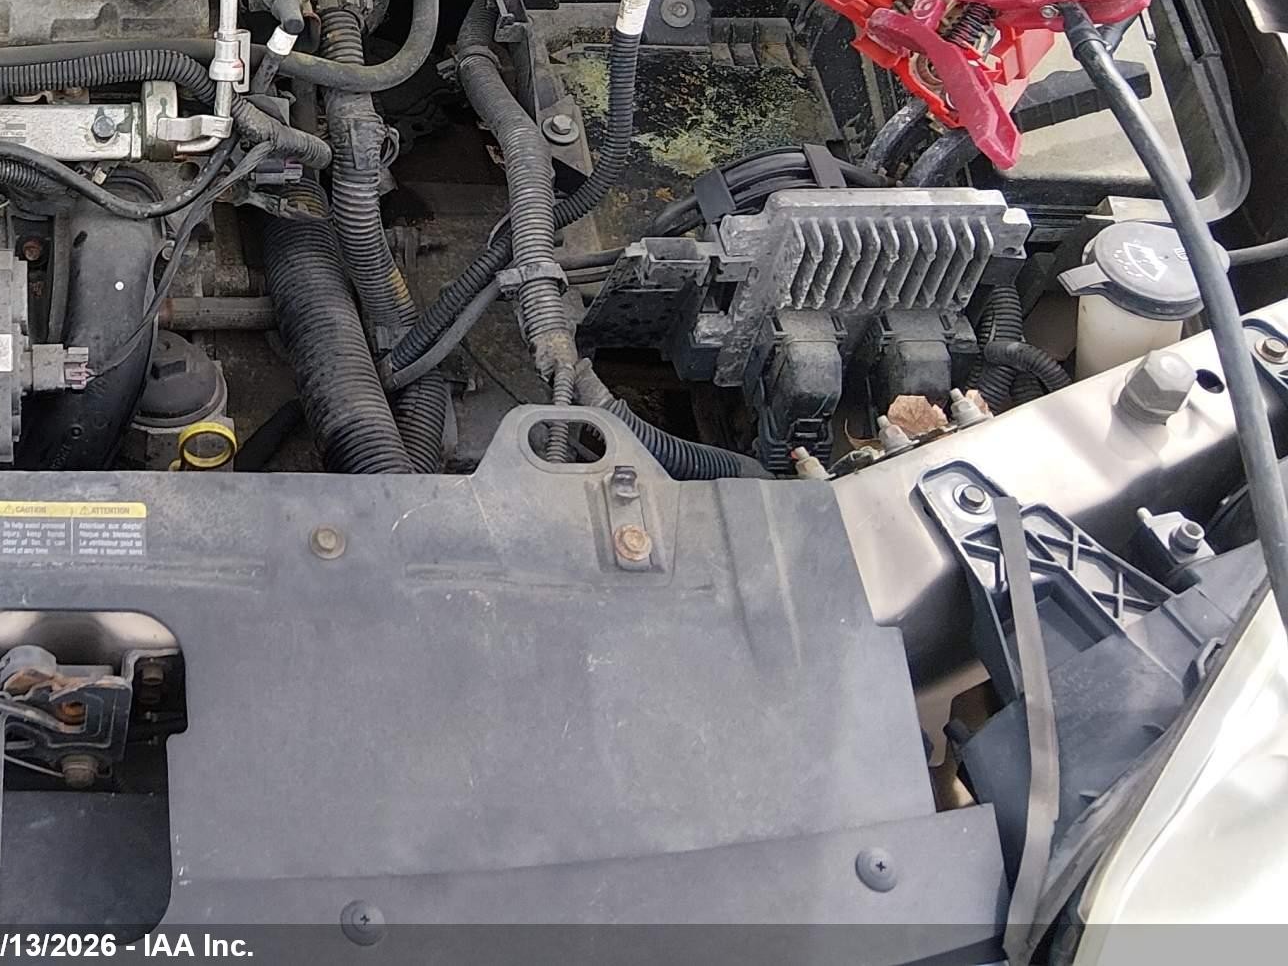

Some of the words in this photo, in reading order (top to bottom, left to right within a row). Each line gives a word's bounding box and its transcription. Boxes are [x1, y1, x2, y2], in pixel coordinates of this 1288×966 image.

[15, 505, 47, 514] CAUTION
[91, 506, 130, 515] ATTENTION
[456, 833, 483, 842] ACA
